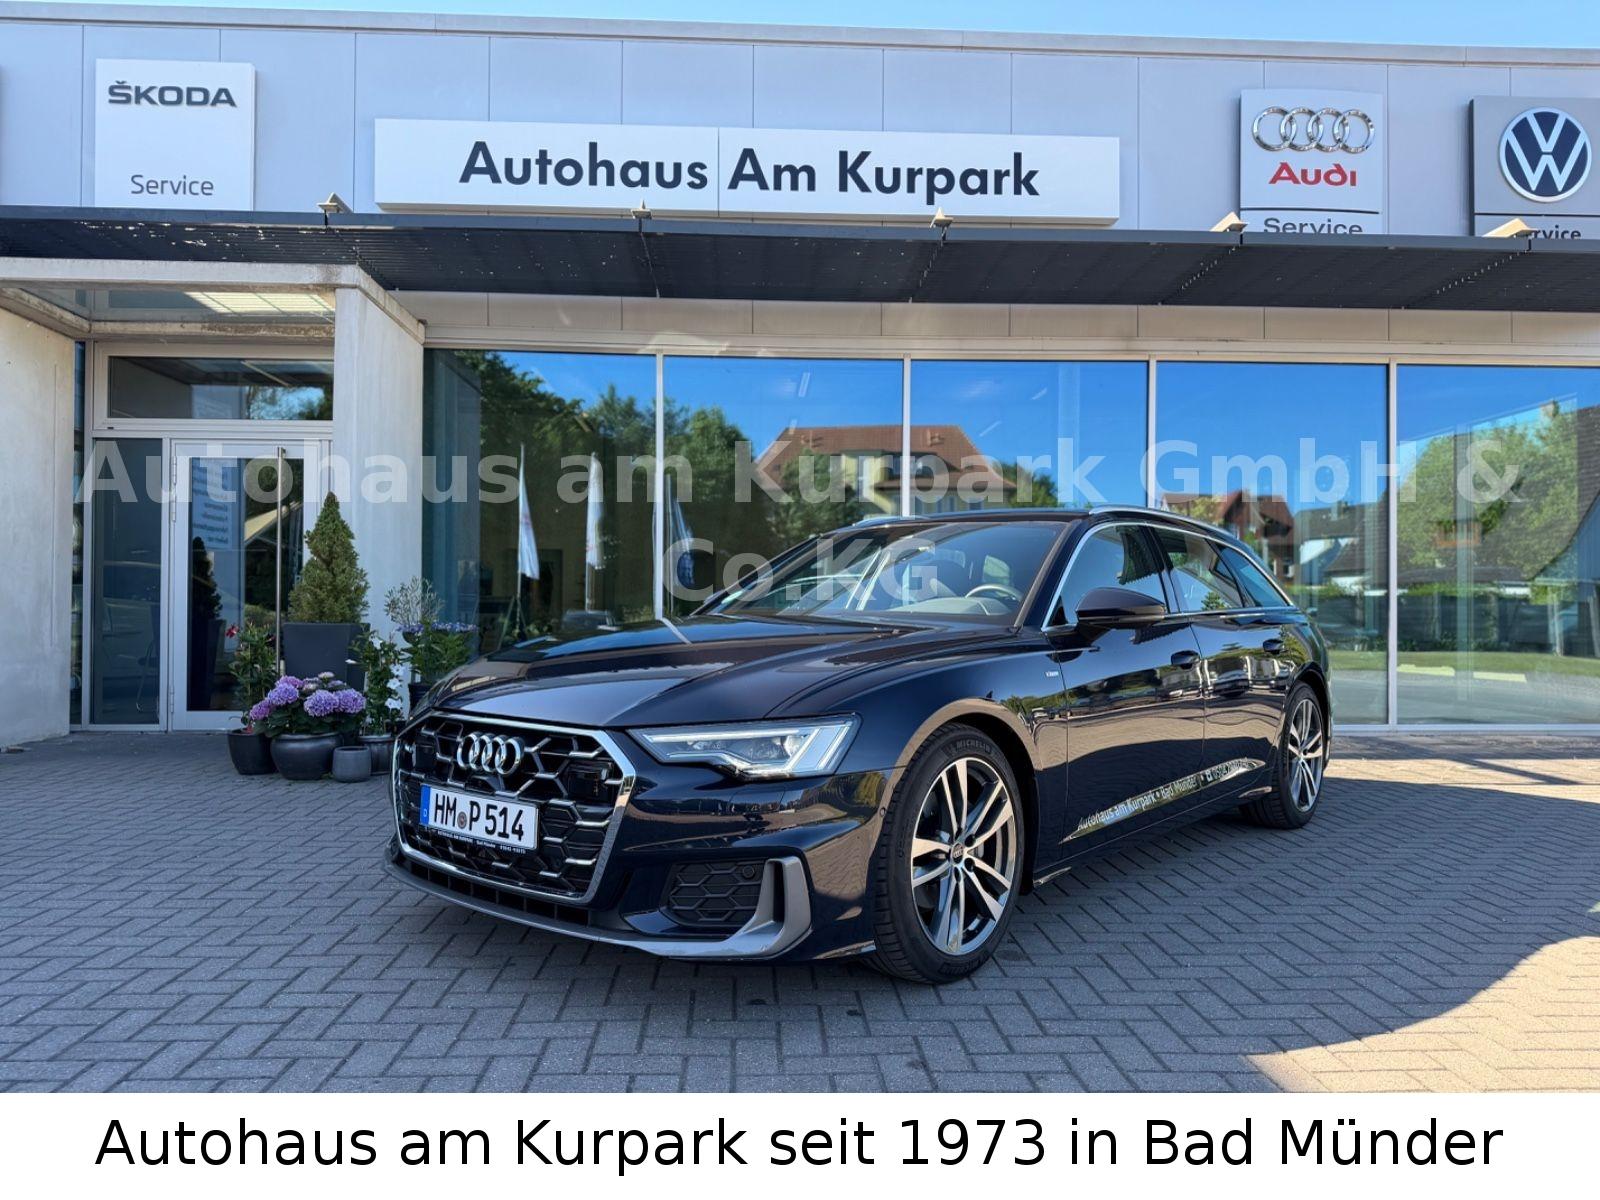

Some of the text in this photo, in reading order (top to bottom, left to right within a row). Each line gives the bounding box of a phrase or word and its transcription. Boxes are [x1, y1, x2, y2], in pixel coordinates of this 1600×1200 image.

[108, 80, 237, 107] ŠKODA
[130, 174, 214, 197] Service
[459, 140, 1040, 206] Autohaus Am Kurpark
[1268, 162, 1357, 187] Audi
[1263, 217, 1363, 235] Service
[1532, 224, 1582, 239] rvice
[434, 793, 524, 841] HM P 514
